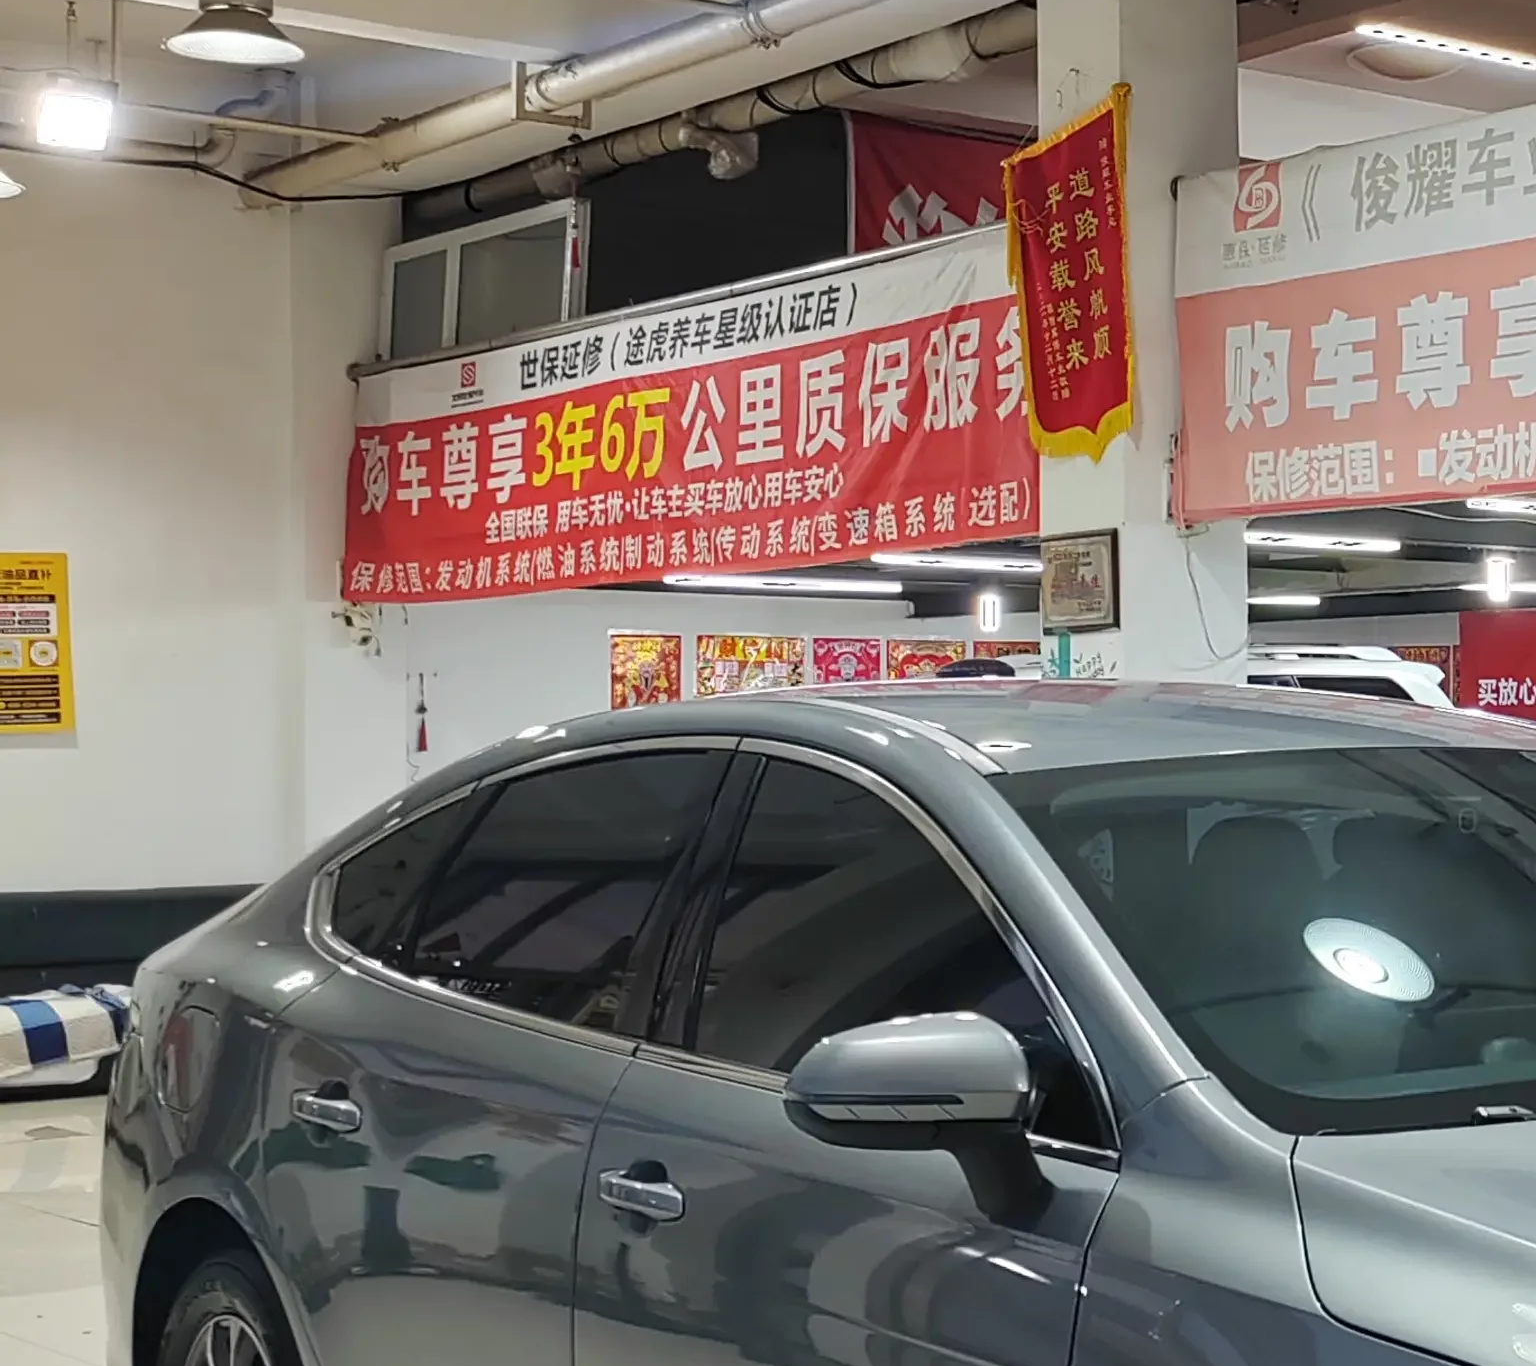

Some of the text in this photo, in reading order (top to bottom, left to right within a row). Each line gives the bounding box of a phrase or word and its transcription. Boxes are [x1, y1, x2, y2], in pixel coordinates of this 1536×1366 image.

[1045, 181, 1090, 373] 平安载誉来
